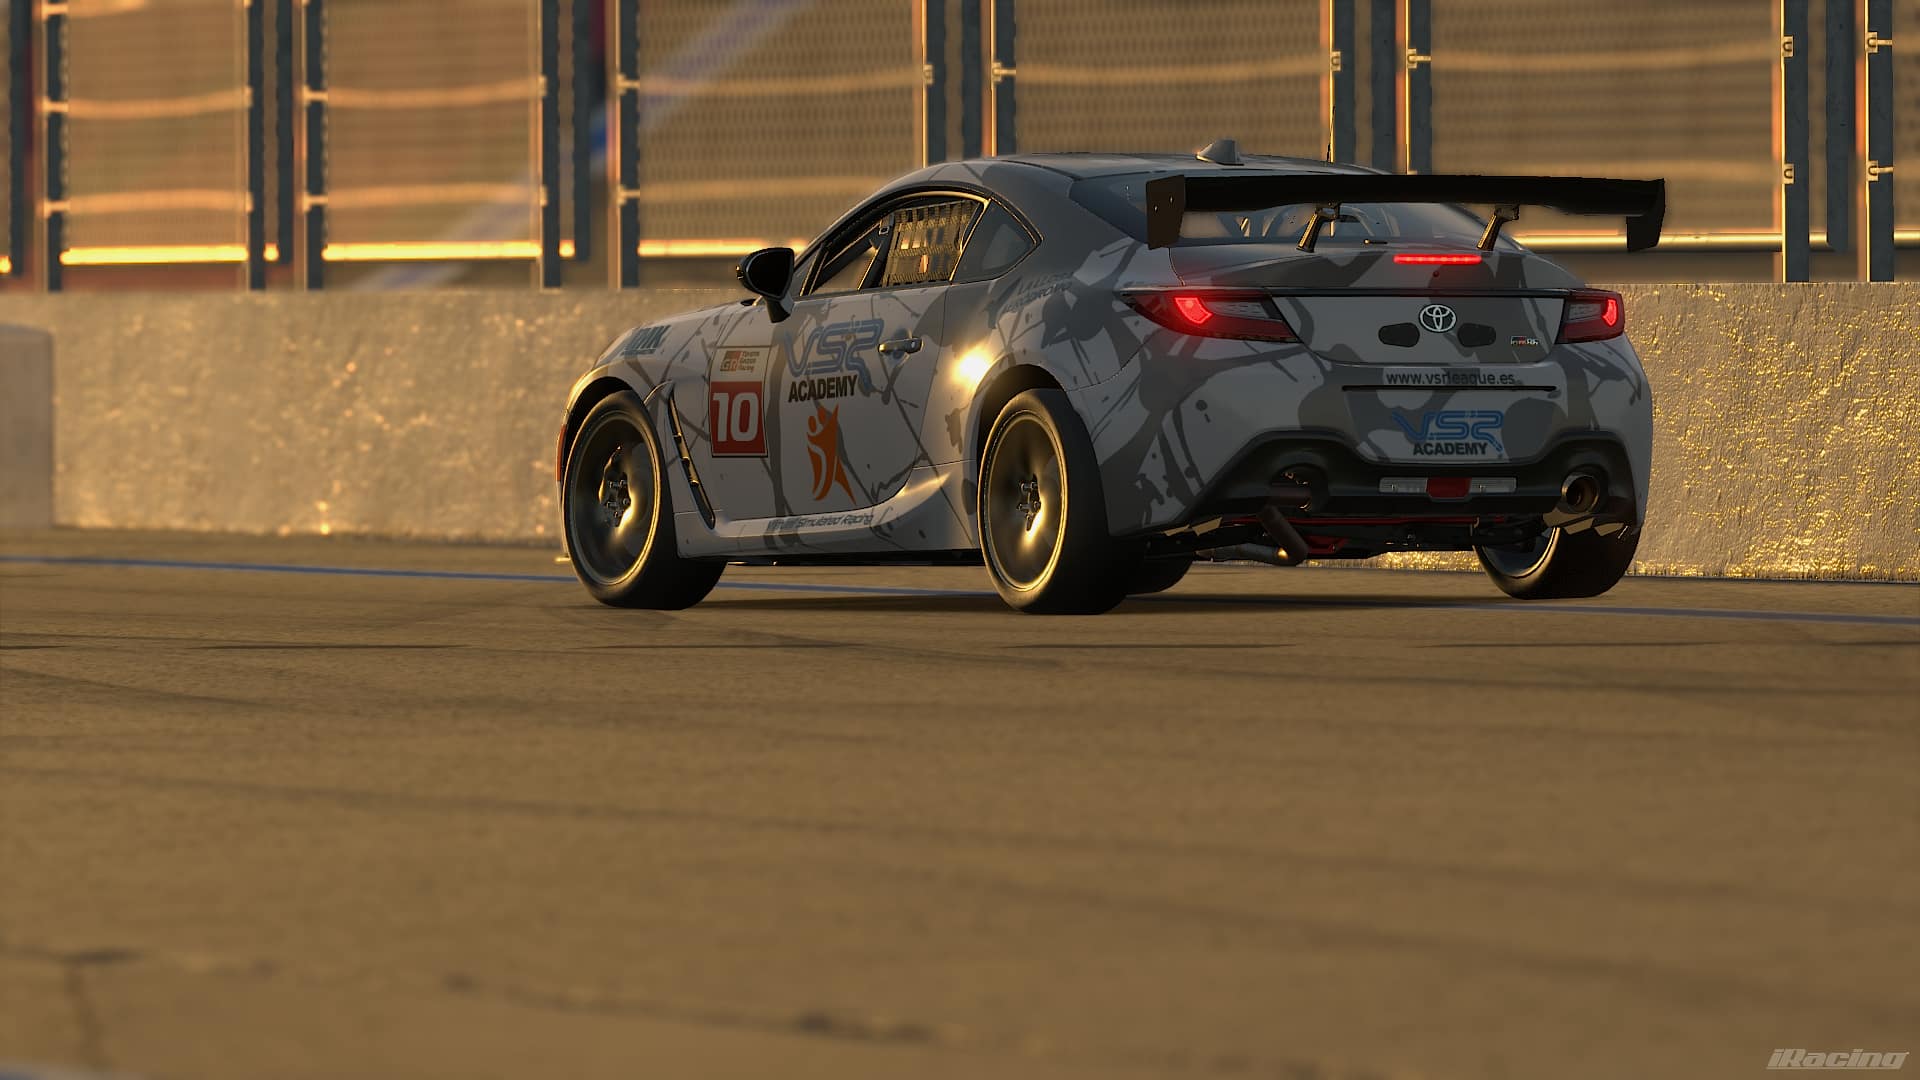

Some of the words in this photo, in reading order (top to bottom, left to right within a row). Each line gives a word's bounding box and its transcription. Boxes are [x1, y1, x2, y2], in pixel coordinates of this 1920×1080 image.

[1386, 370, 1515, 385] www.vsrleague.es
[788, 375, 858, 403] ACADEMY
[712, 392, 760, 442] 10
[1413, 443, 1488, 456] ACADEMY
